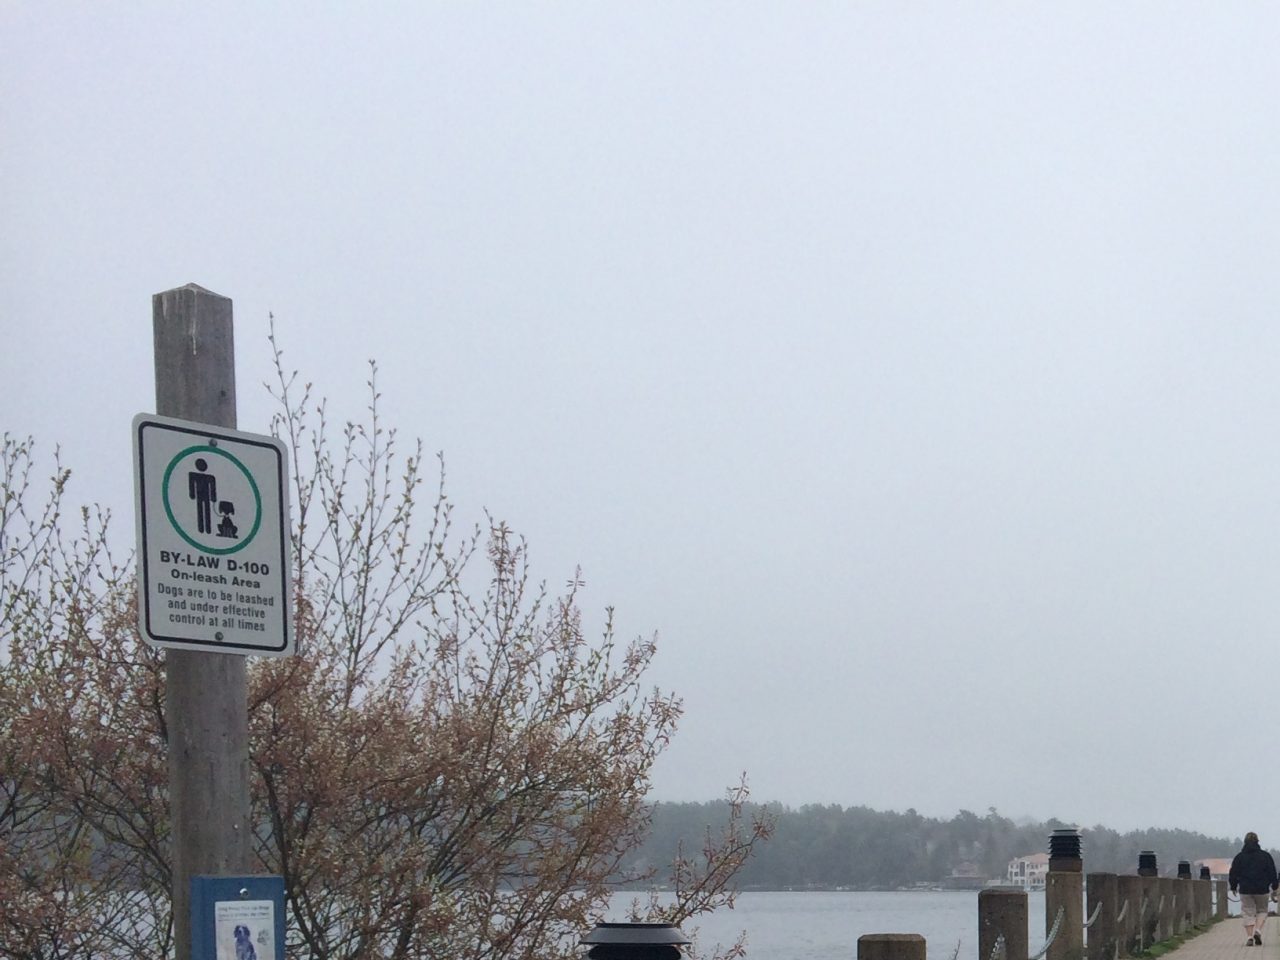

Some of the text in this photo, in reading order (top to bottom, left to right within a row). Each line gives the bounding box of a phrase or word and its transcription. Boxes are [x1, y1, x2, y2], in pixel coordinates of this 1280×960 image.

[160, 550, 270, 576] BY-LAW D-100
[171, 568, 261, 589] On-leash Area
[157, 582, 274, 607] Dogs are to be leashed
[167, 599, 266, 619] and under effective
[169, 613, 266, 632] control at all times
